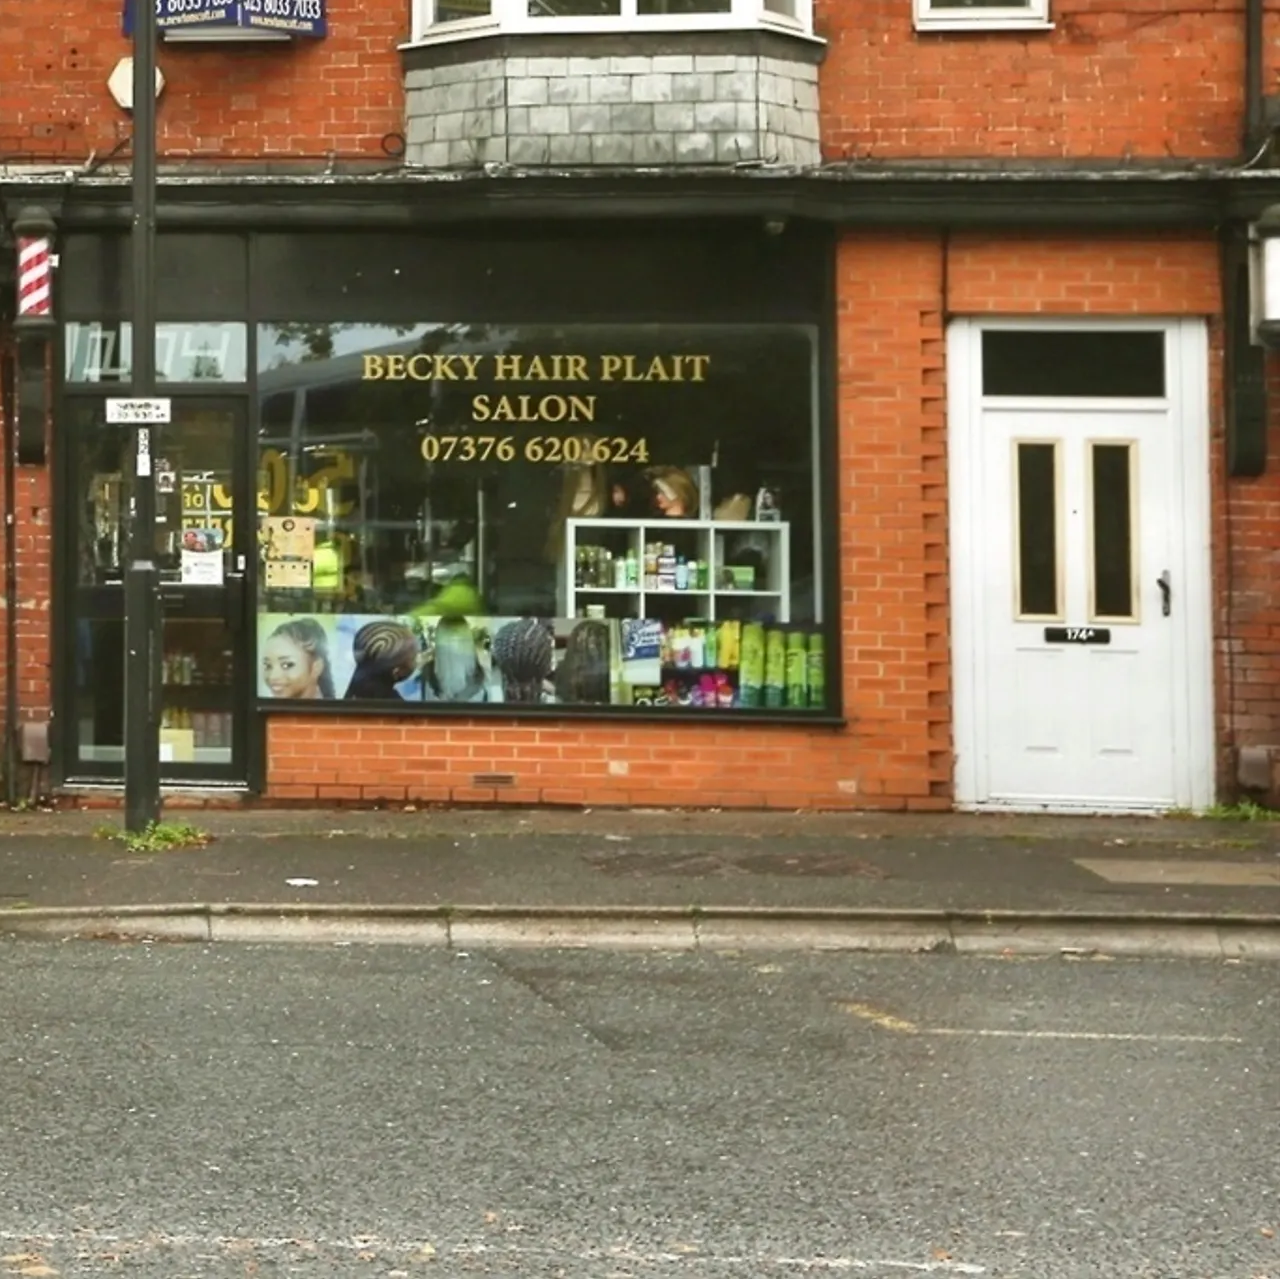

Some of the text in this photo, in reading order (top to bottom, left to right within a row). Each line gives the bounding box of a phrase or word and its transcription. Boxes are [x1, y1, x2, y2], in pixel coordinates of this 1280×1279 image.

[362, 354, 710, 381] BECKY HAIR PLAIT
[472, 395, 597, 422] SALON
[421, 436, 650, 464] 07376 620 624
